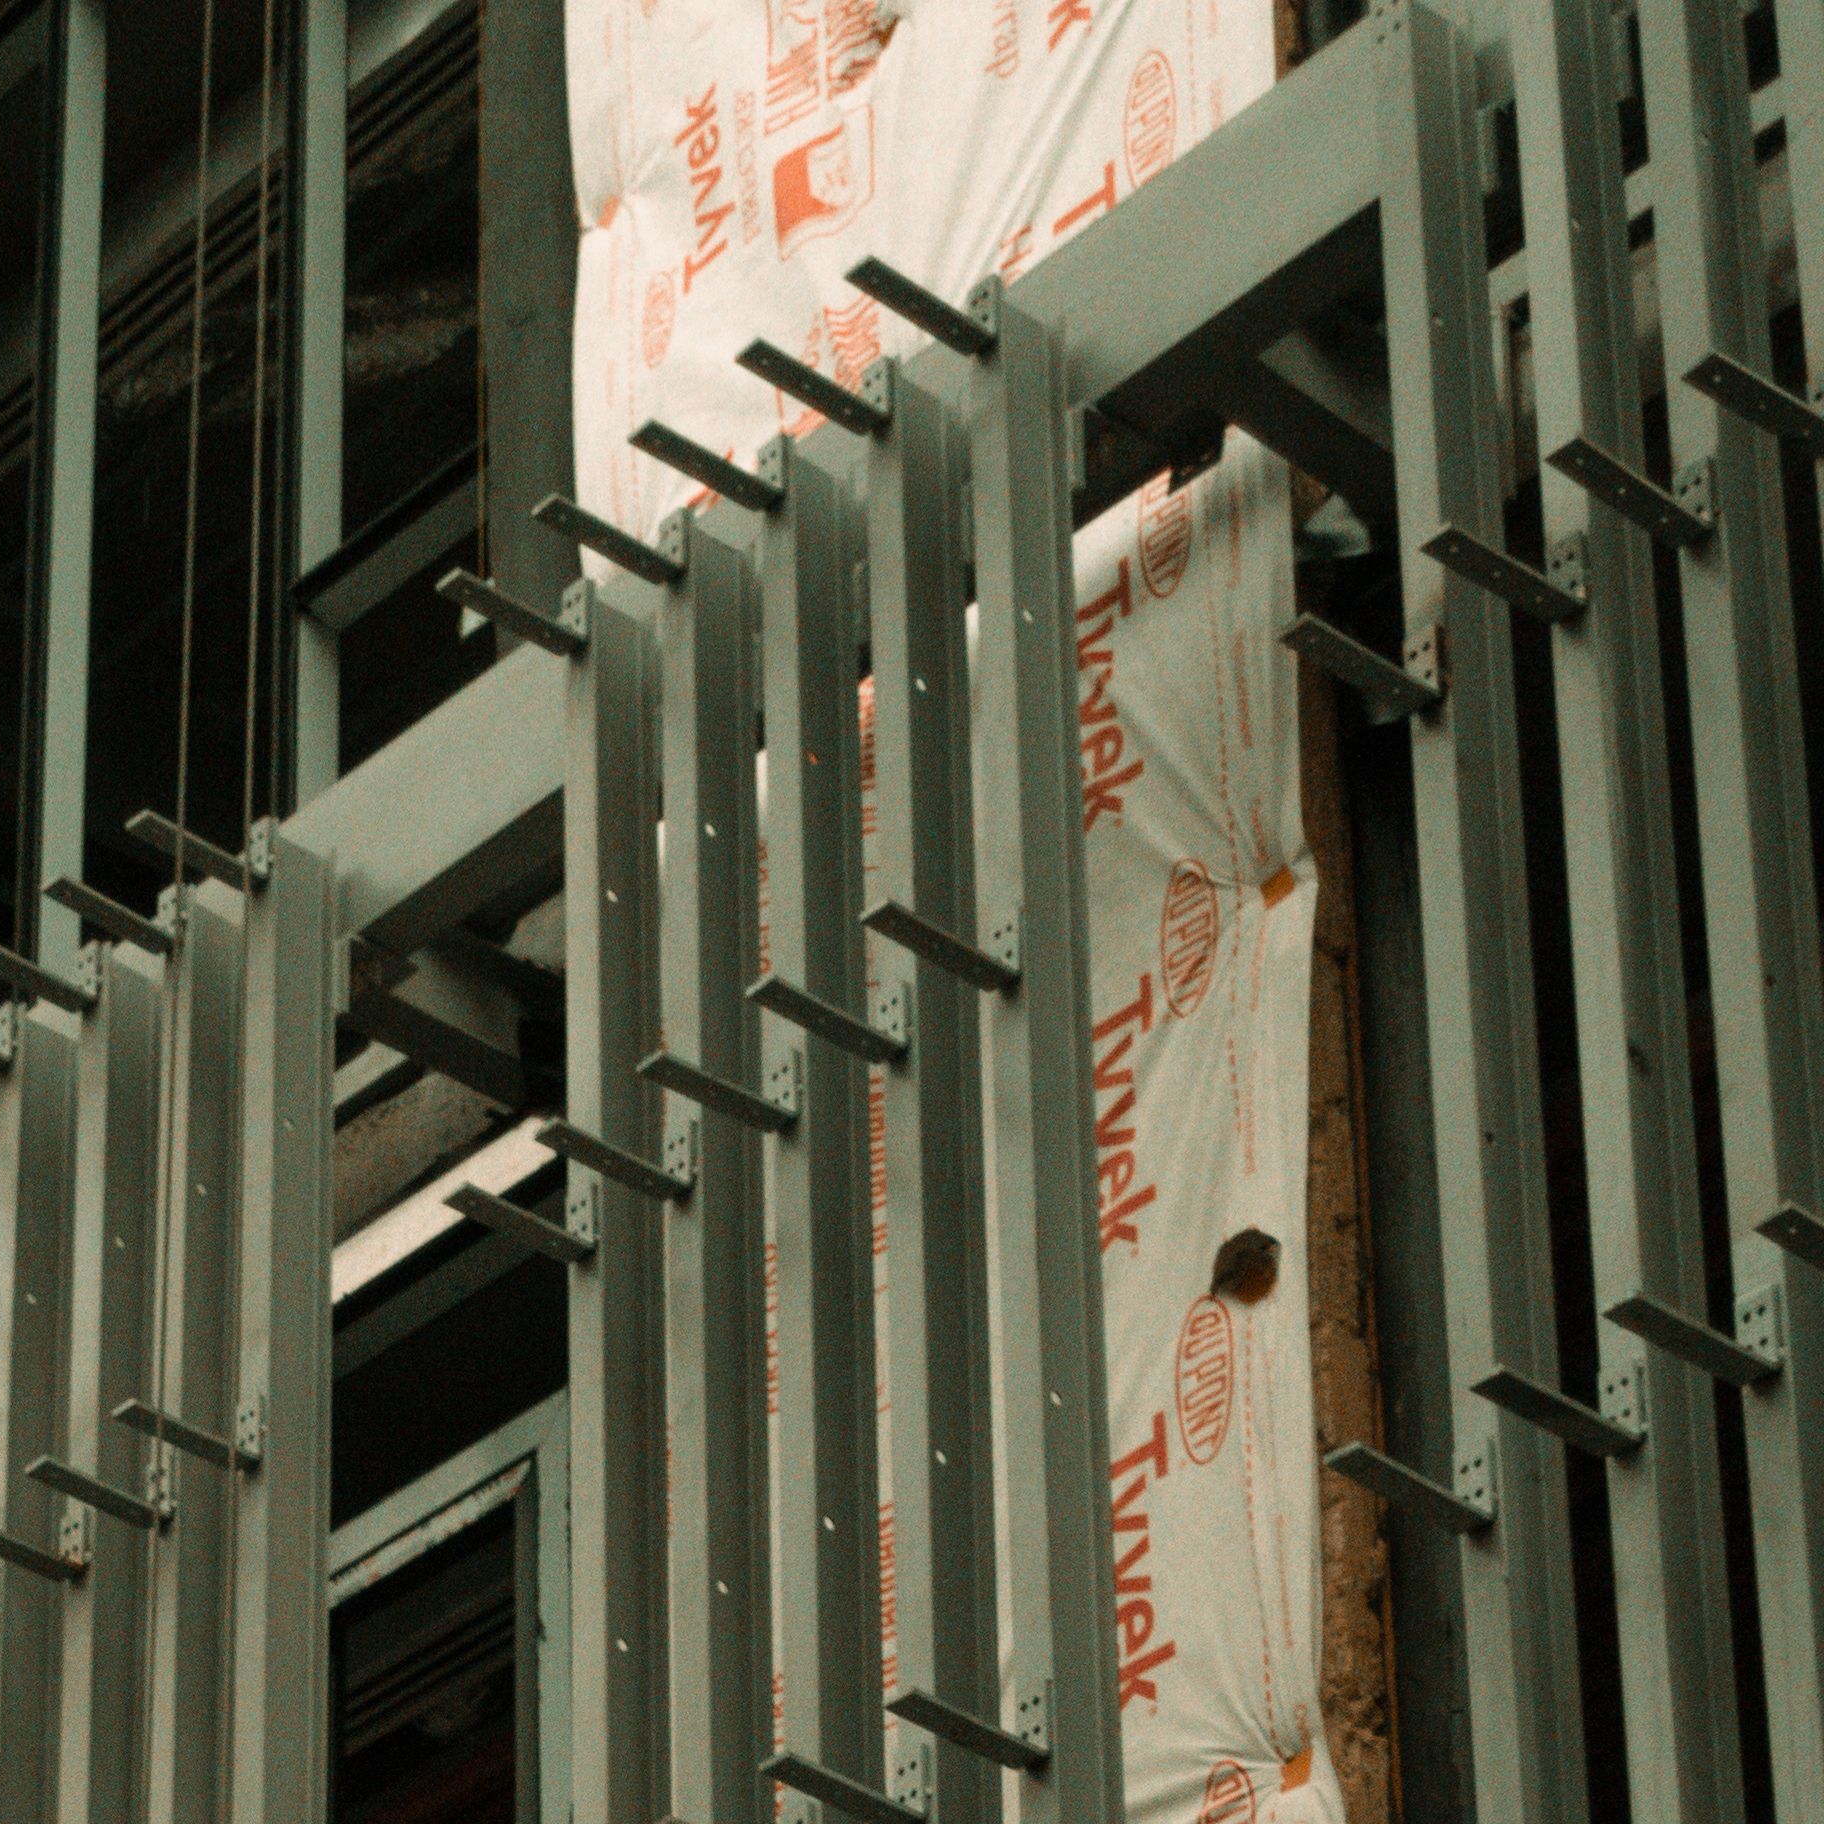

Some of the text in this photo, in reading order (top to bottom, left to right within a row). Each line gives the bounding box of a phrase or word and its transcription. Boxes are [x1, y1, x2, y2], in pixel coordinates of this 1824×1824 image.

[676, 82, 736, 296] Tyvek
[1074, 556, 1144, 830] Tyvek
[1090, 973, 1157, 1255] Tyvek
[1110, 1410, 1176, 1713] Tyvek
